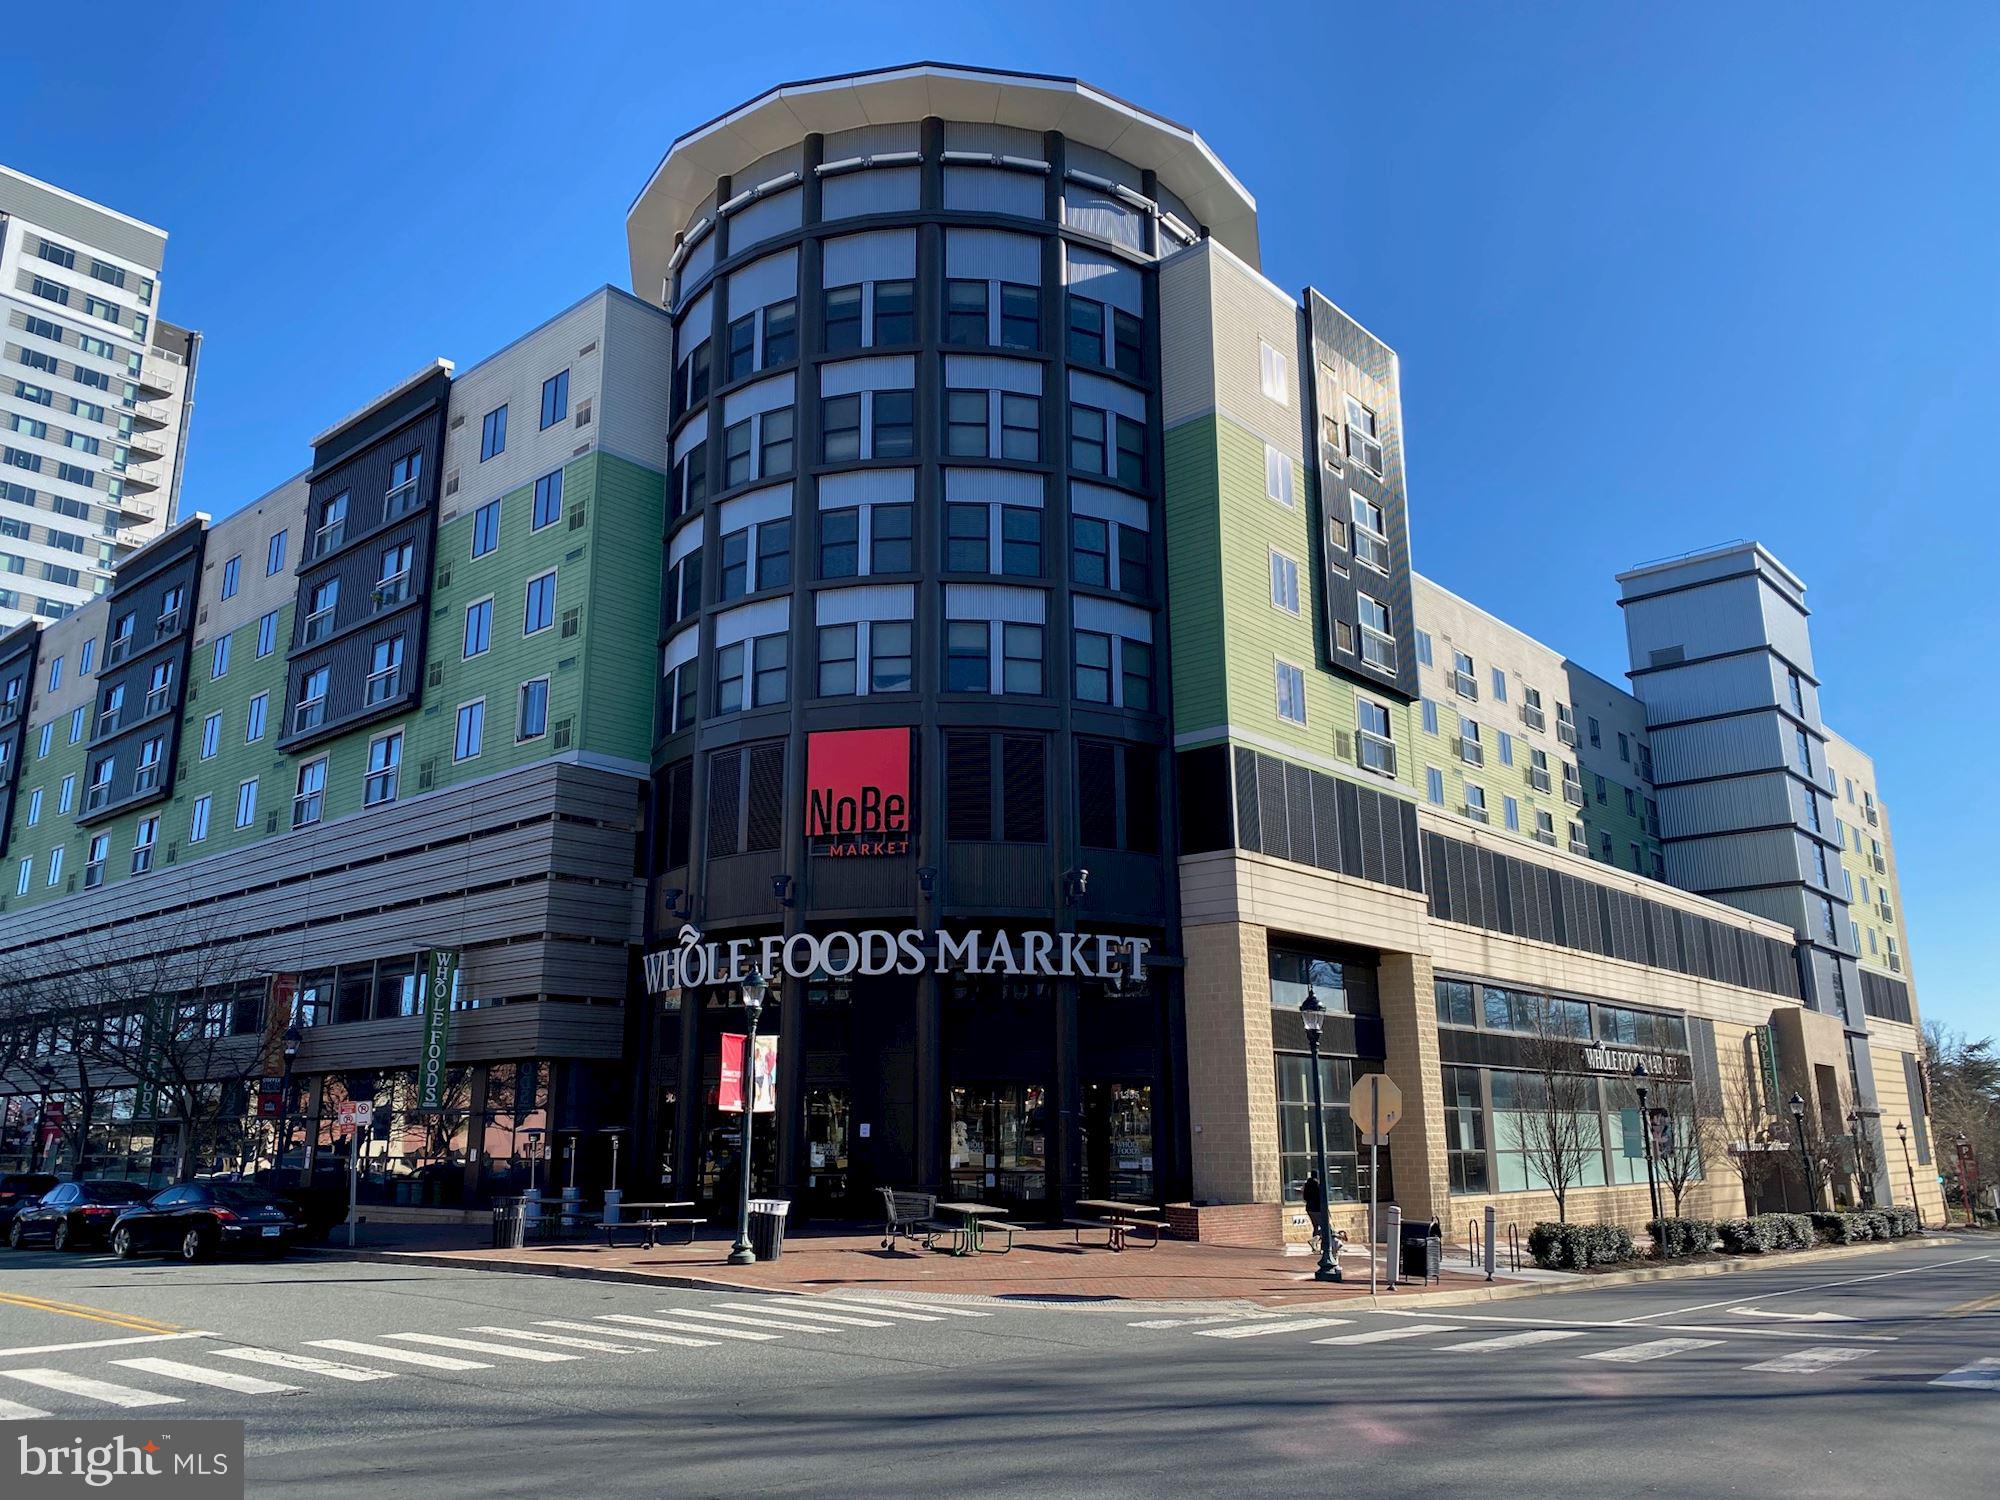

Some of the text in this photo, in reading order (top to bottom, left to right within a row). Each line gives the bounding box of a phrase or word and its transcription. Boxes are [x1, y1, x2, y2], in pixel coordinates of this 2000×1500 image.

[810, 786, 905, 835] NoBe
[830, 842, 909, 857] MARKET
[642, 923, 1151, 995] WHOLE FOODS MARKET
[425, 952, 451, 1102] WHOLE FOODS
[1585, 1040, 1618, 1070] WHOLE
